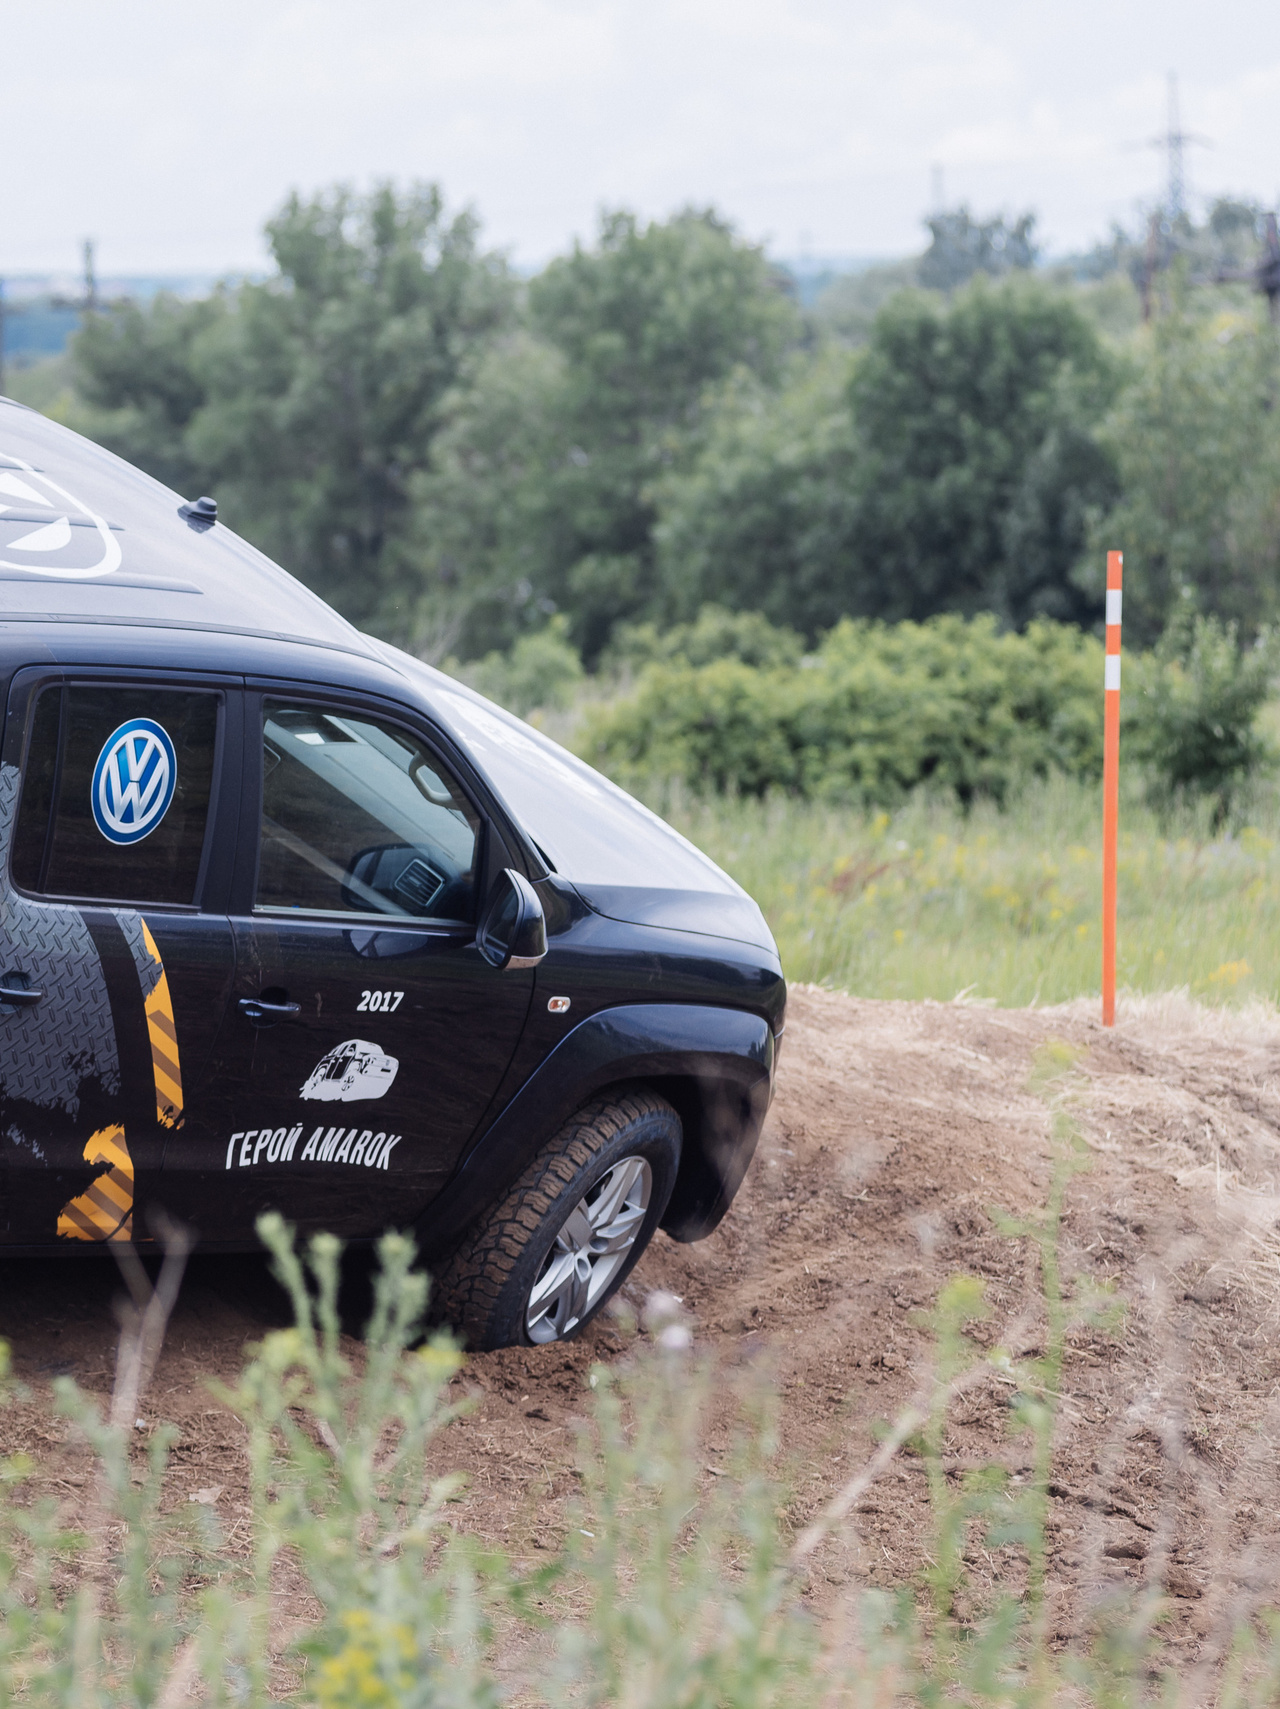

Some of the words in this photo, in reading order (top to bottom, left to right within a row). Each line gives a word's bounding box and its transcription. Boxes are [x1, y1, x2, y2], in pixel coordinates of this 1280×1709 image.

[356, 990, 404, 1012] 2017
[225, 1122, 303, 1170] ГЕРОЙ
[301, 1127, 402, 1170] AMAROK
